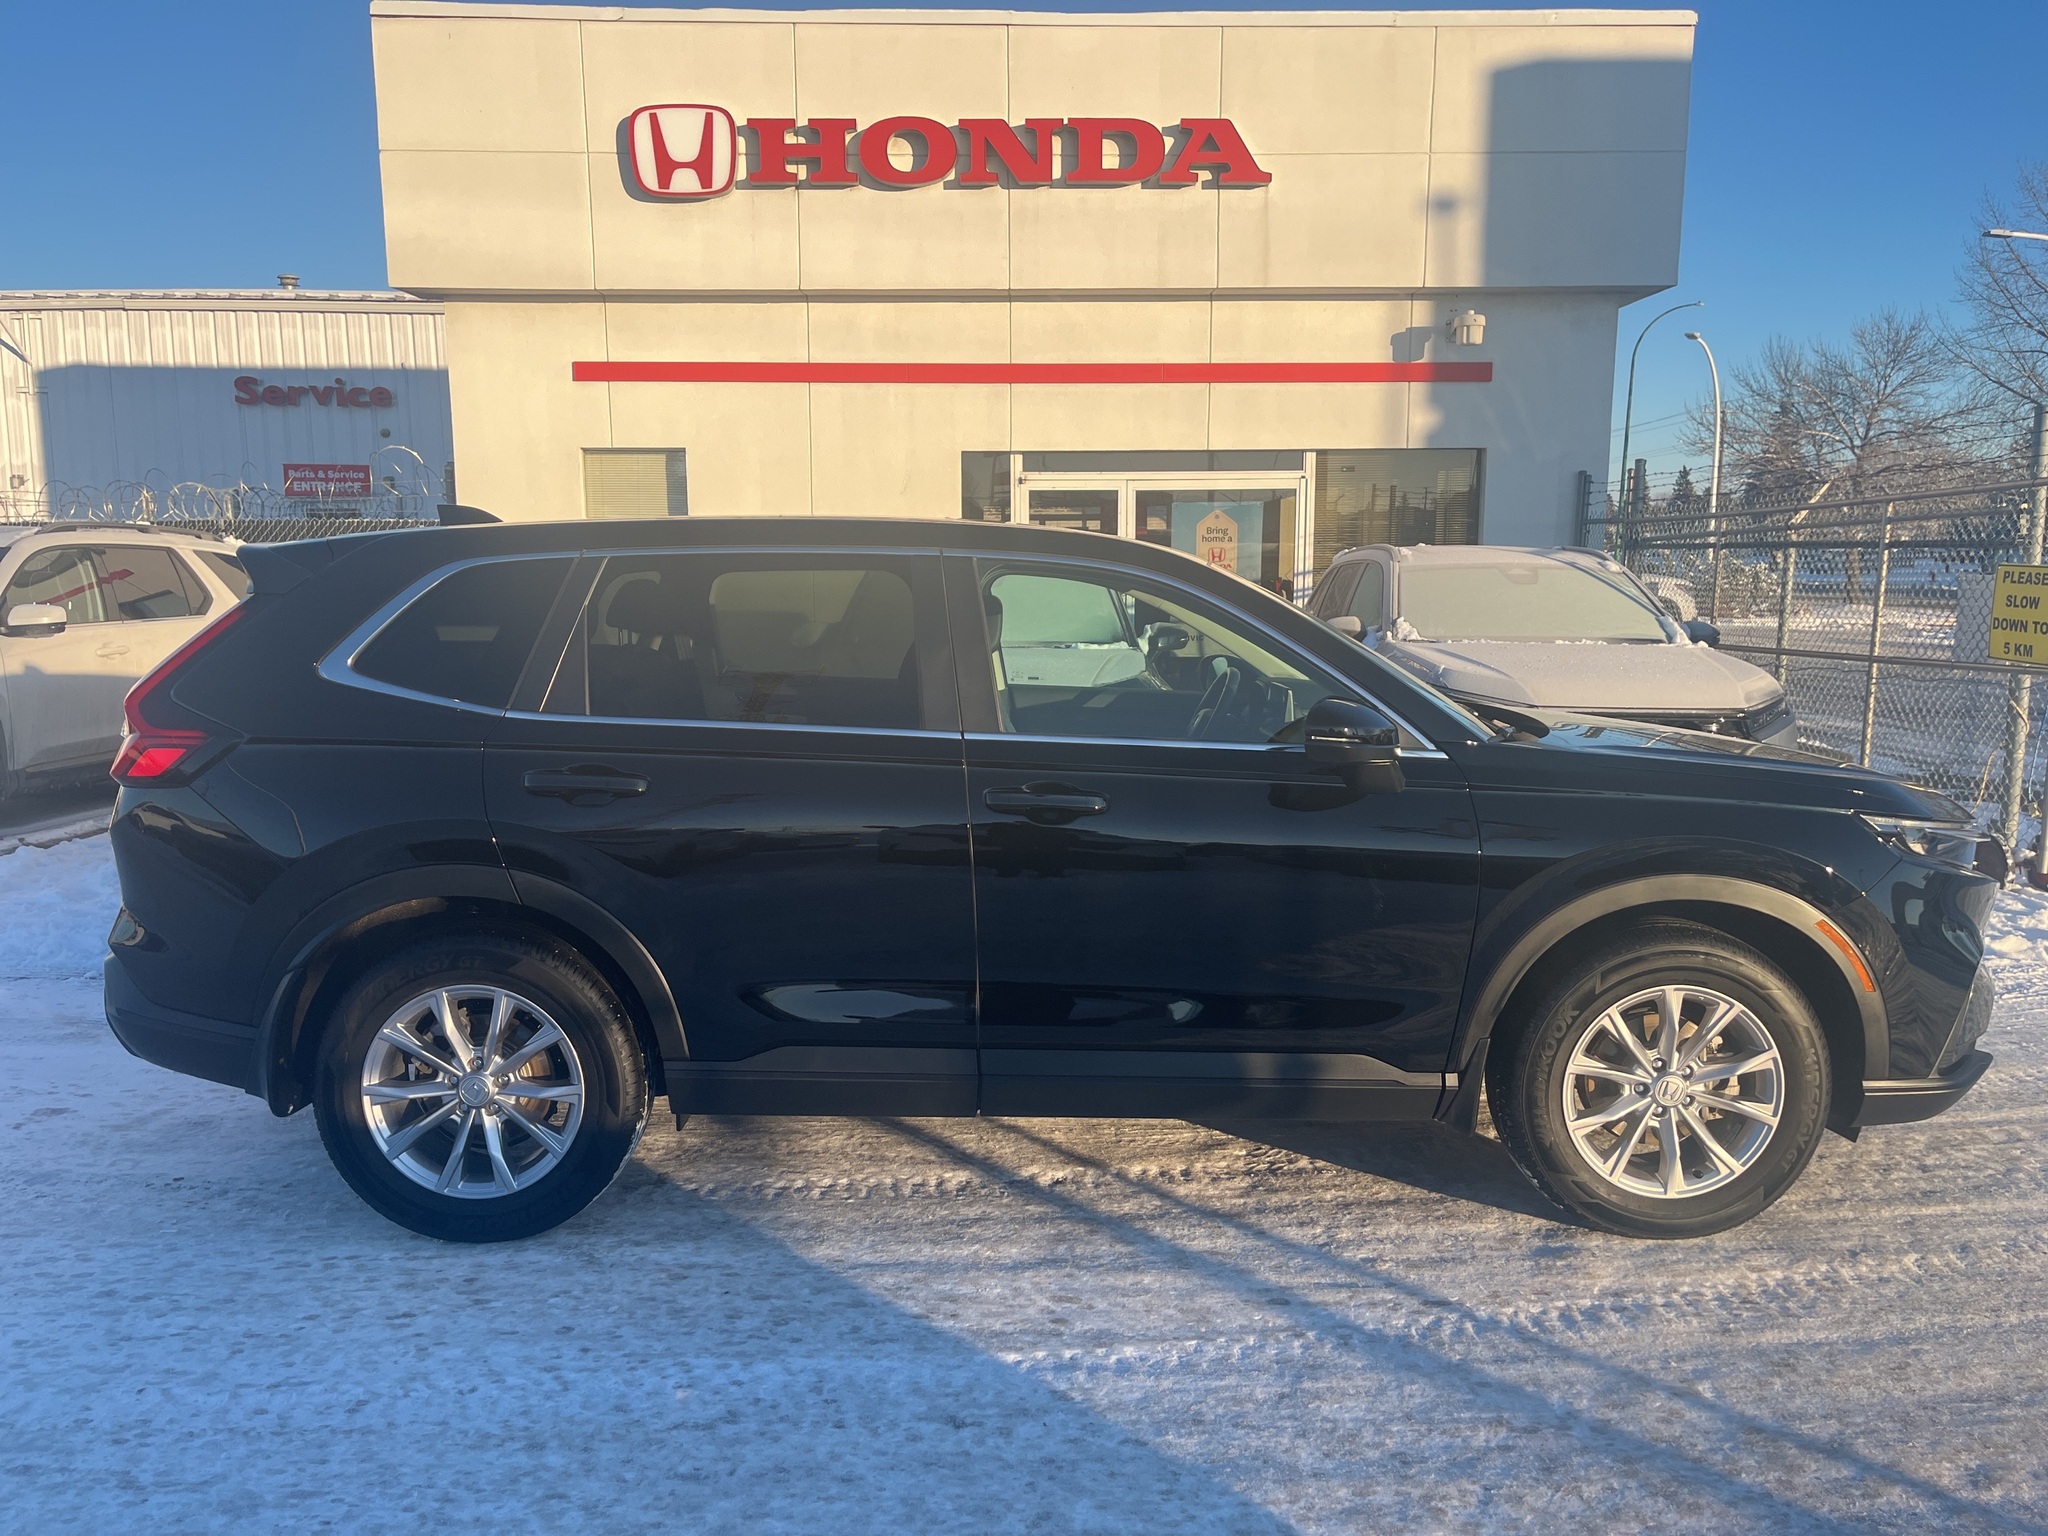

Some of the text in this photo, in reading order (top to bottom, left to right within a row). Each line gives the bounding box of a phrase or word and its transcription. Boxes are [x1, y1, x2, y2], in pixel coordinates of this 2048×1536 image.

[747, 116, 1271, 187] HONDA
[234, 376, 393, 407] Service
[288, 470, 365, 479] Parts & Service
[293, 481, 362, 492] ENTRANCE
[1206, 527, 1229, 536] Bring
[2002, 571, 2048, 585] PLEASE
[2005, 594, 2040, 609] SLOW
[1992, 617, 2048, 635] DOWN TO
[2003, 642, 2033, 657] 5 KM
[1780, 1149, 1798, 1173] GT
